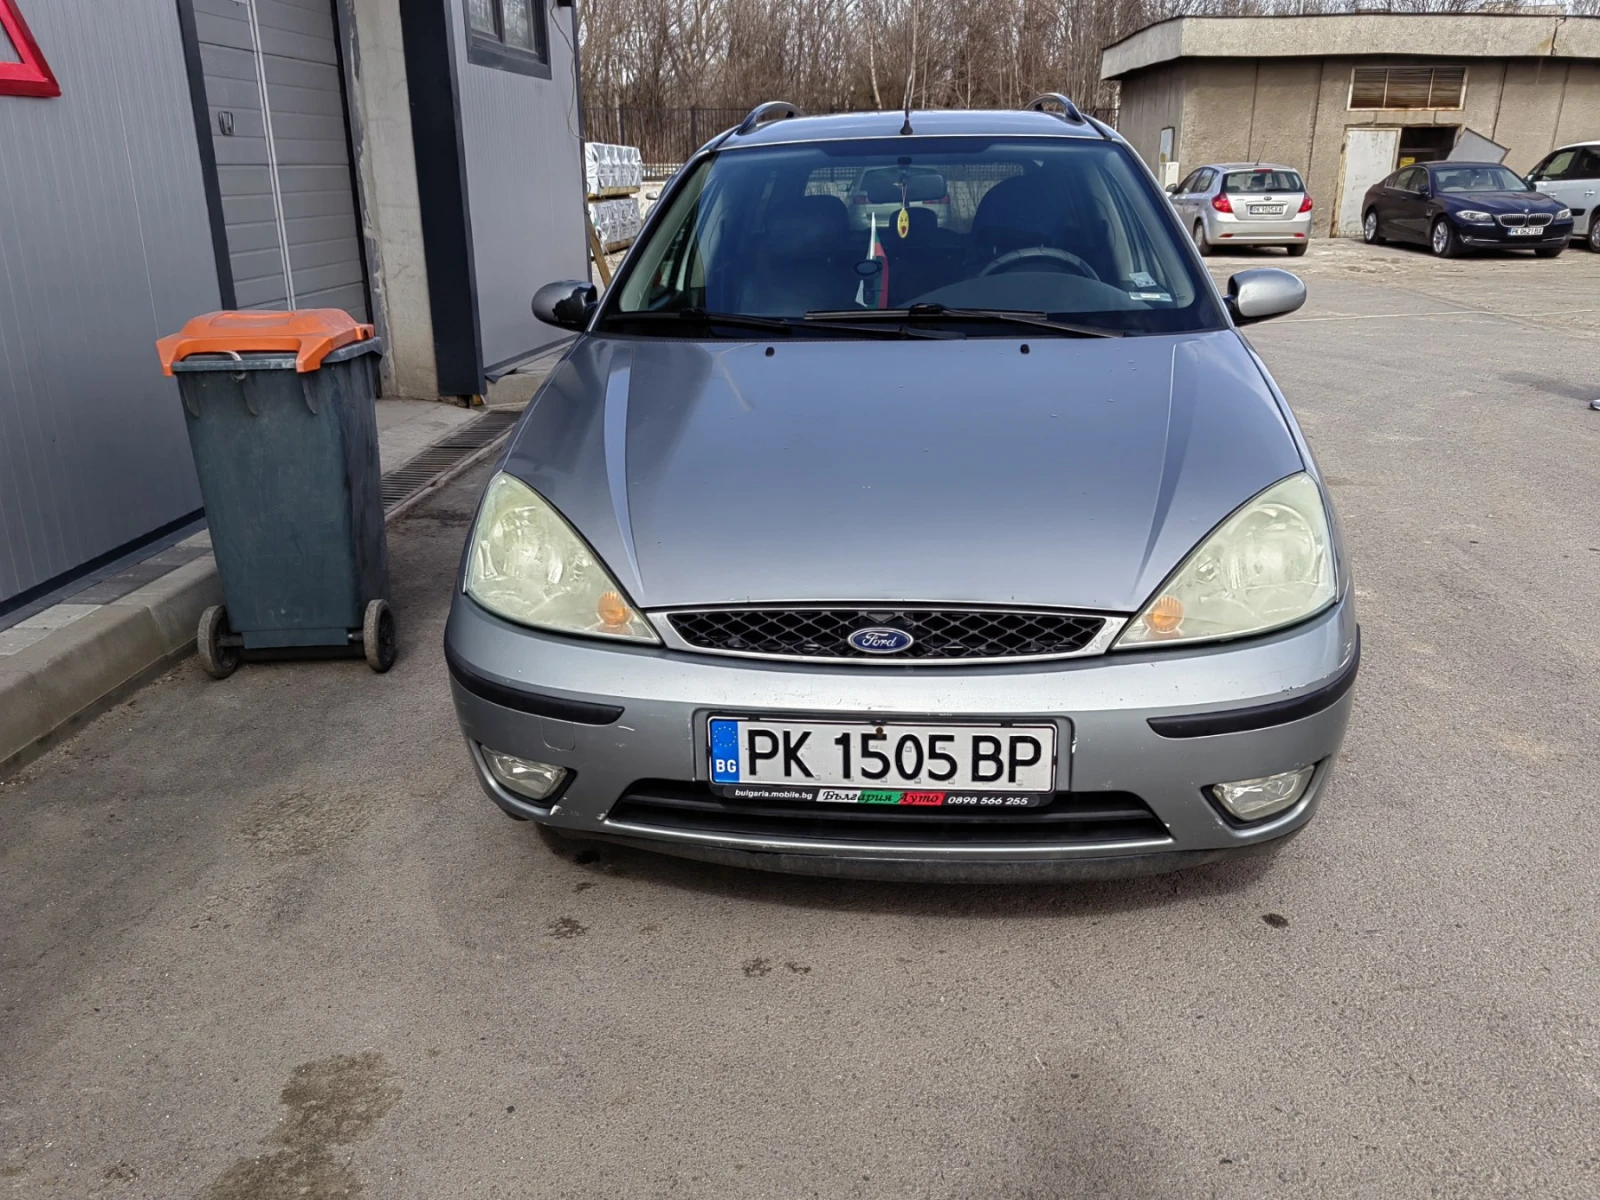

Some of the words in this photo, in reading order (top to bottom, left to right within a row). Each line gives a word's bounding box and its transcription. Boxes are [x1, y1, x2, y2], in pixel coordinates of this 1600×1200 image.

[862, 631, 898, 647] Ford
[747, 729, 815, 778] PK
[834, 732, 958, 781] 1505
[971, 735, 1042, 783] BP
[715, 759, 737, 773] BG
[734, 789, 813, 800] bulgaria.mobile.bg
[947, 796, 977, 804] 0898
[980, 797, 1003, 805] 566
[1005, 797, 1028, 806] 255
